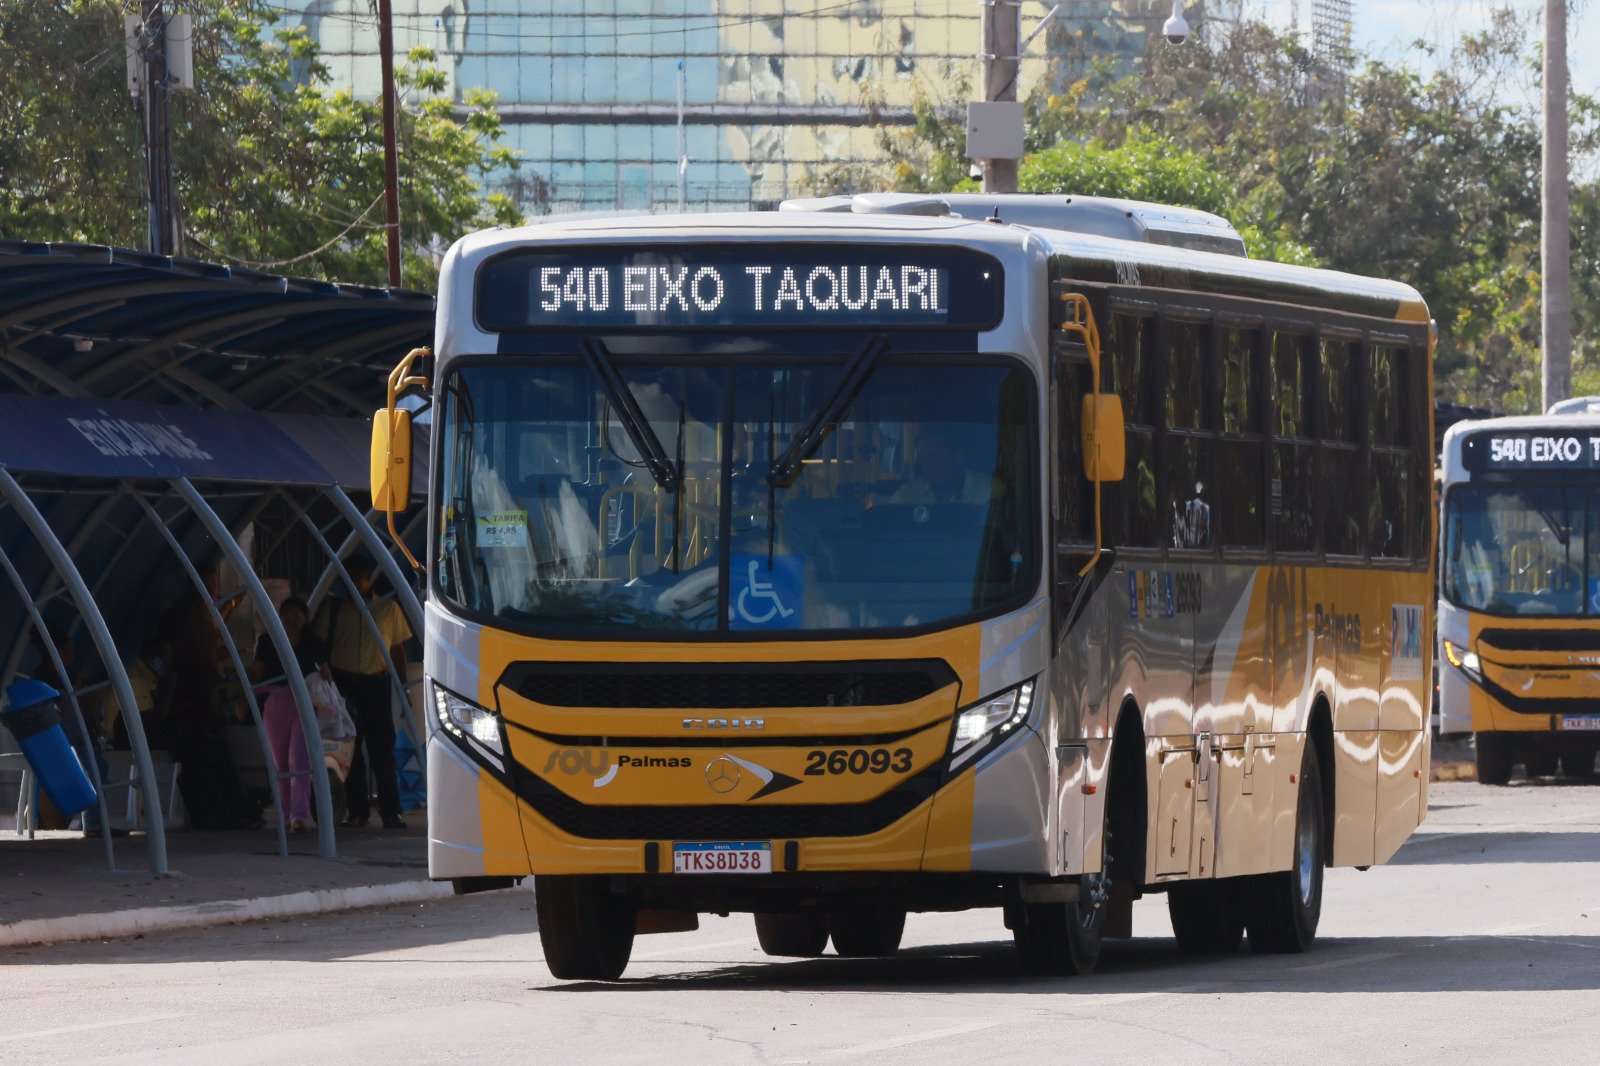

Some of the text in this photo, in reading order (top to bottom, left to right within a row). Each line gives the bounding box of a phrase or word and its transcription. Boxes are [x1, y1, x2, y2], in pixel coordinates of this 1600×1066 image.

[541, 266, 939, 311] 540 EIXO TAQUARI
[1491, 438, 1526, 461] 540
[1531, 437, 1581, 461] EIXO
[682, 718, 765, 730] CAIO
[618, 755, 692, 768] Palmas
[804, 748, 913, 775] 26093
[682, 852, 761, 870] TKS8D38
